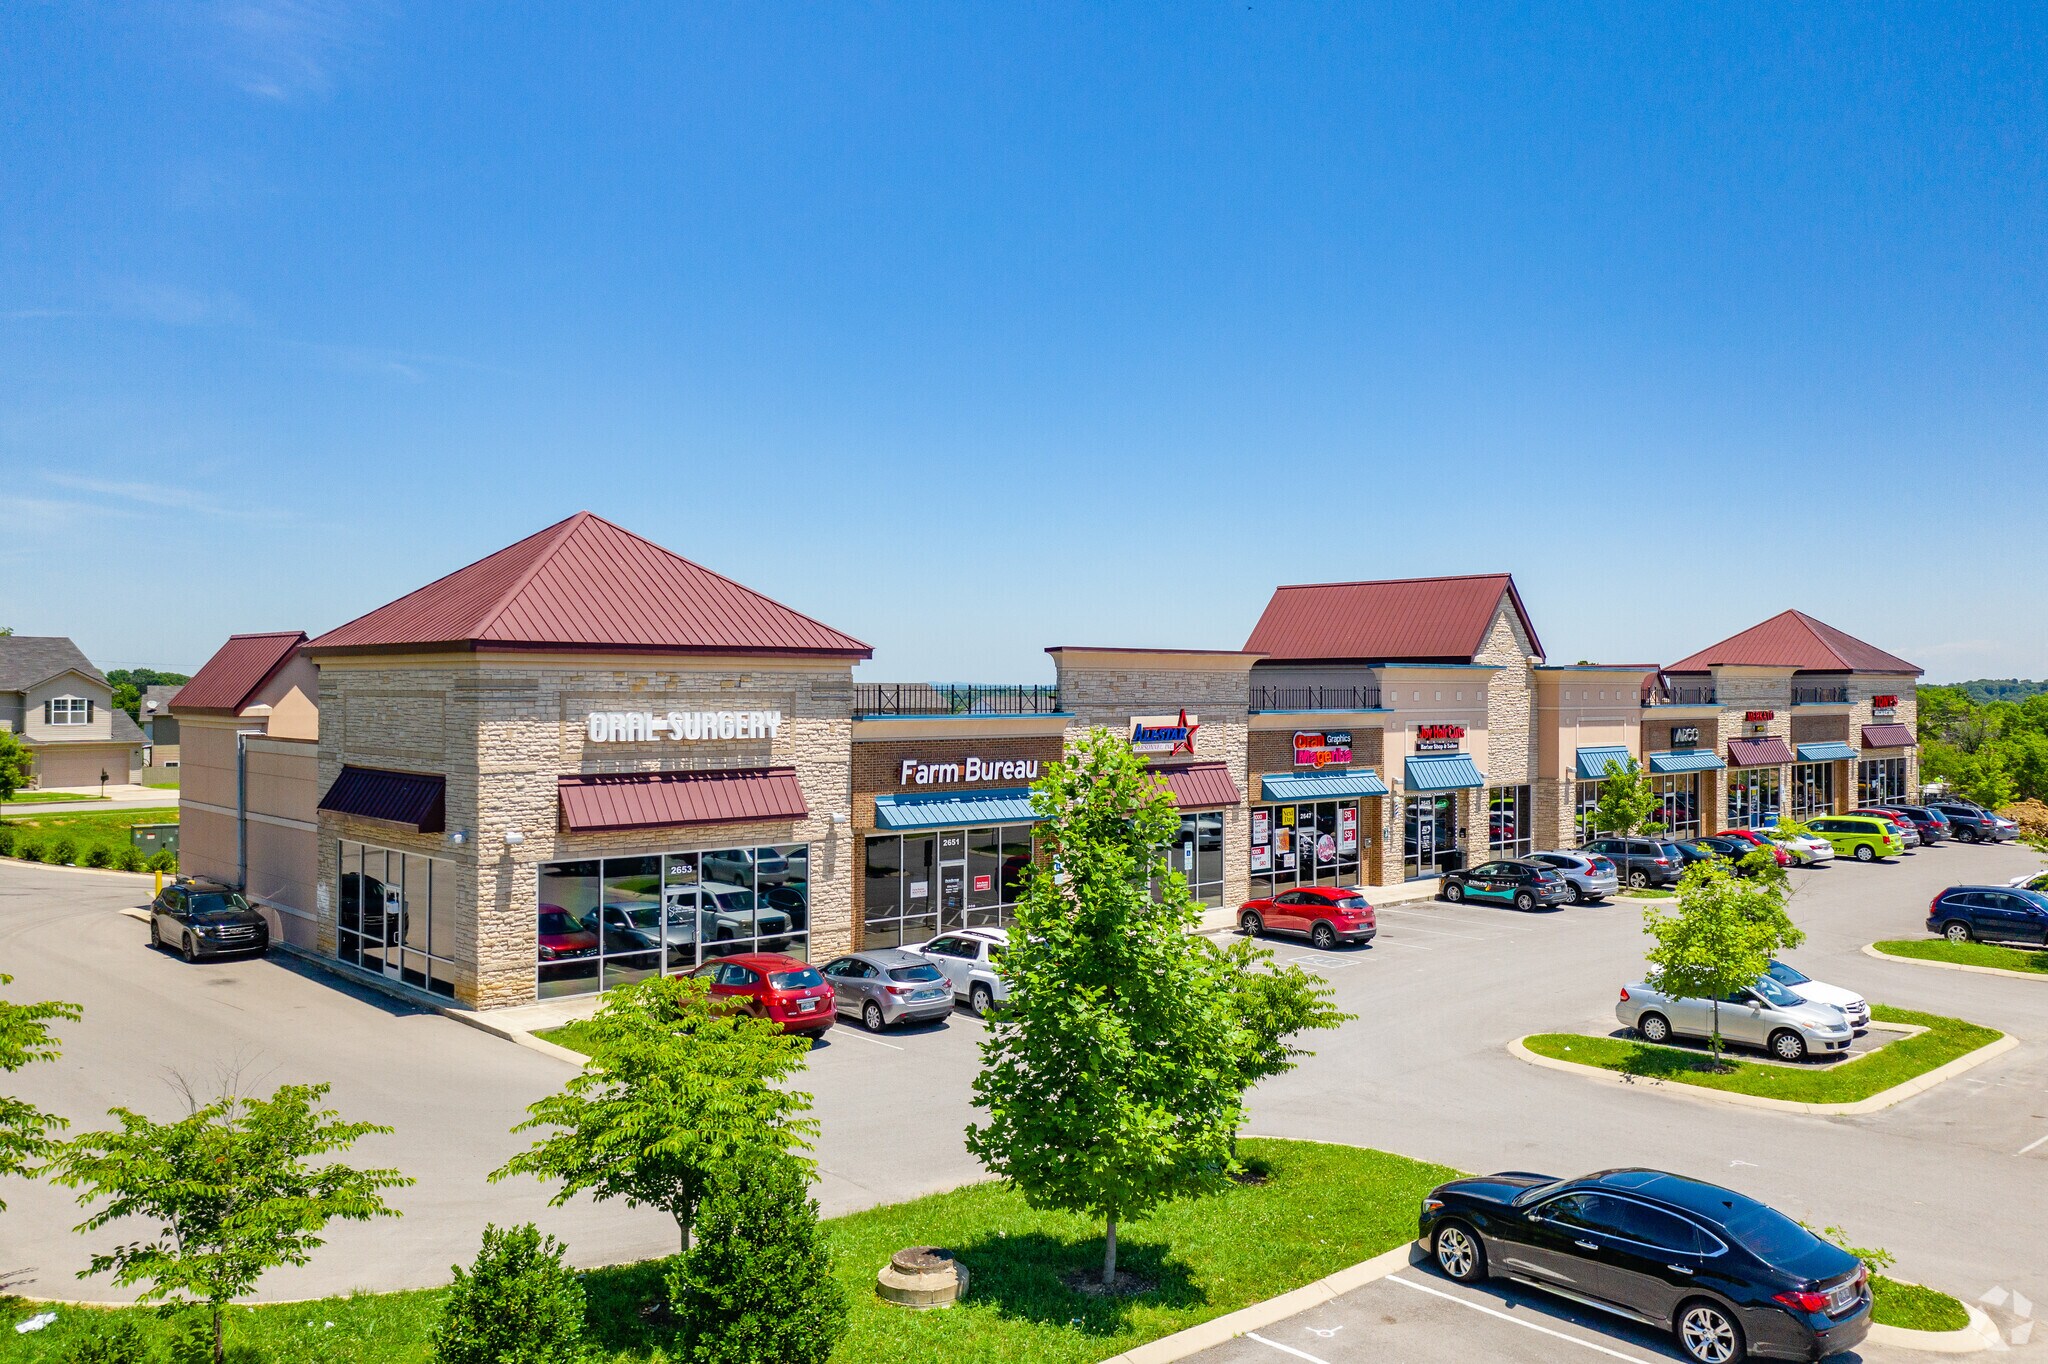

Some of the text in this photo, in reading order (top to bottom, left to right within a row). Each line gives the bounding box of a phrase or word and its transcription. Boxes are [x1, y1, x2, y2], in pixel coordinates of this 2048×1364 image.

[1875, 695, 1899, 707] TONY'S
[588, 711, 781, 742] ORAL SURGERY
[1326, 734, 1351, 745] Graphics
[1296, 748, 1353, 767] Magenta
[901, 757, 1038, 785] Farm Bureau
[943, 838, 960, 847] 2651
[671, 865, 693, 875] 2653
